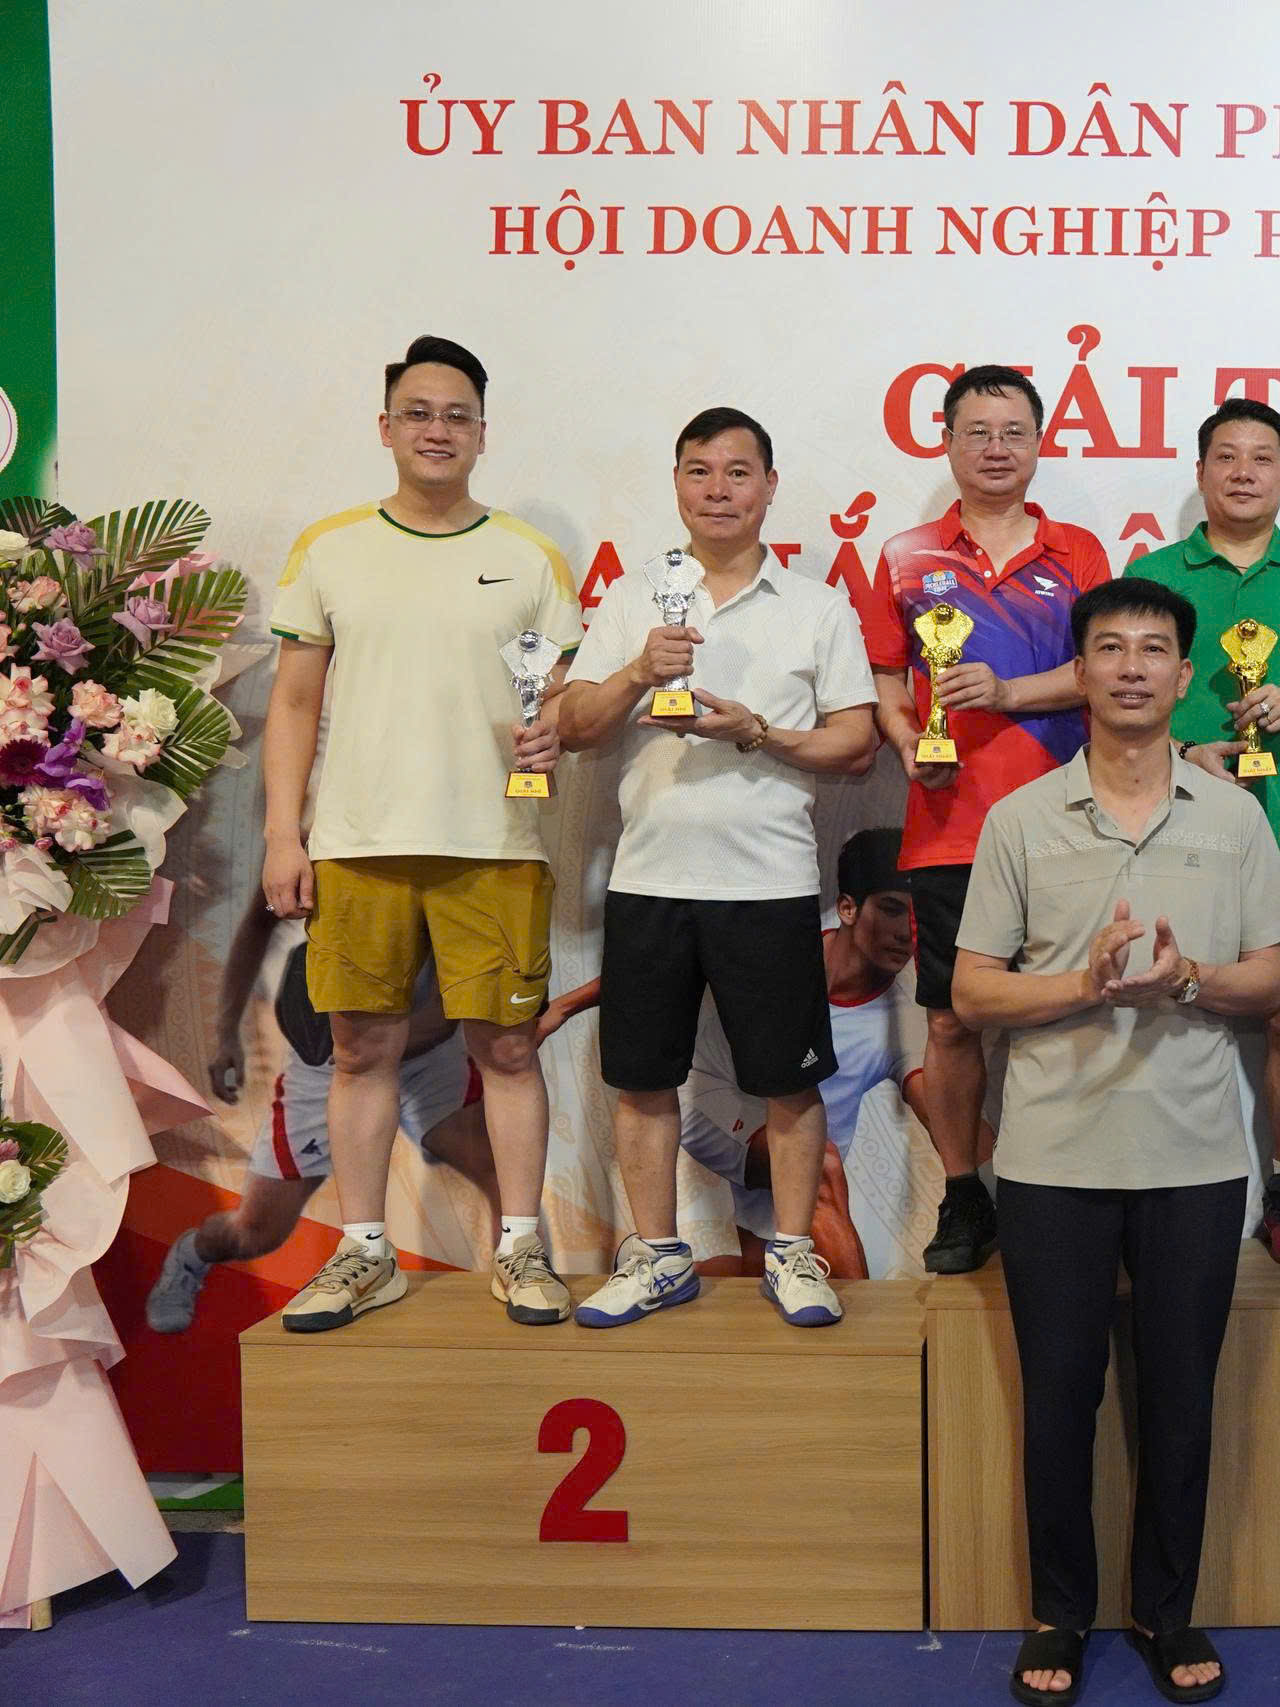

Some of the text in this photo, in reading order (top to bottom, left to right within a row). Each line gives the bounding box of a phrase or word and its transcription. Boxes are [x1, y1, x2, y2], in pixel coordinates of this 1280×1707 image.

[400, 72, 517, 157] ỦY
[537, 98, 712, 157] BAN
[737, 80, 983, 157] NHÂN
[1008, 81, 1187, 158] DÂN
[488, 188, 625, 272] HỘI
[646, 204, 913, 257] DOANH
[935, 191, 1231, 272] NGHIỆP
[538, 1398, 629, 1543] 2
